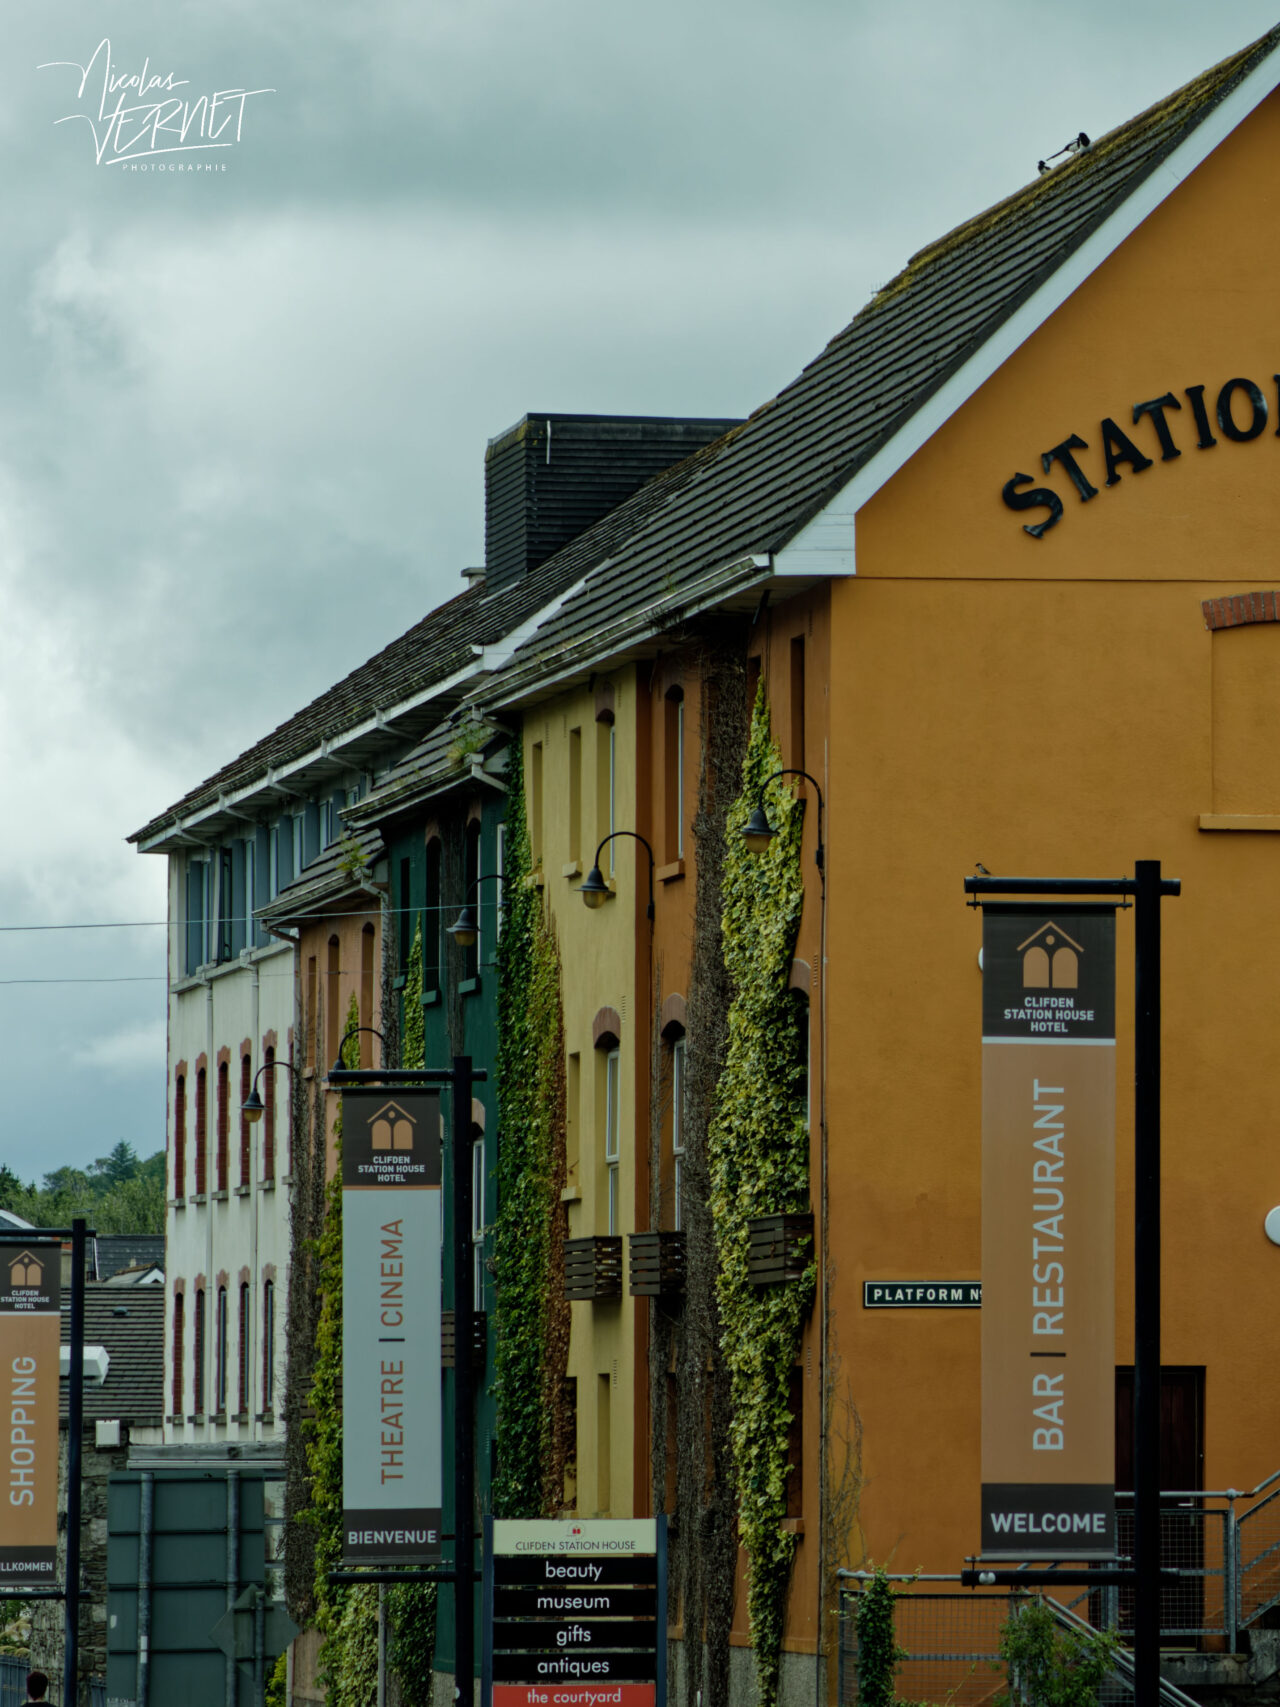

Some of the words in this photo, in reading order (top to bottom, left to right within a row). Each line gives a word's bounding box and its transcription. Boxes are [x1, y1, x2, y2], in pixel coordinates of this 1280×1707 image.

[1024, 996, 1075, 1008] CLIFDEN
[1003, 1008, 1053, 1020] STATION
[1055, 1010, 1095, 1021] HOUSE
[1030, 1021, 1069, 1033] HOTEL
[373, 1155, 411, 1164] CLIFDEN
[357, 1164, 394, 1173] STATION
[396, 1164, 425, 1173] HOUSE
[377, 1173, 406, 1182] HOTEL
[1033, 1078, 1065, 1336] RESTAURANT
[380, 1219, 404, 1327] CINEMA
[11, 1289, 40, 1297] CLIFDEN
[873, 1288, 963, 1301] PLATFORM
[14, 1302, 36, 1310] HOTEL
[1033, 1373, 1065, 1451] BAR
[380, 1360, 404, 1485] THEATRE
[10, 1356, 37, 1507] SHOPPING
[990, 1513, 1106, 1534] WELCOME
[348, 1530, 437, 1545] BIENVENUE
[515, 1541, 556, 1551] CLIFDEN
[559, 1541, 600, 1551] STATION
[602, 1540, 636, 1550] HOUSE
[0, 1562, 53, 1572] LLKOMMEN
[545, 1560, 602, 1582] beauty
[537, 1596, 610, 1610] museum
[556, 1625, 592, 1646] gifts
[537, 1657, 610, 1678] antiques
[527, 1688, 548, 1703] the
[553, 1688, 622, 1706] courtyard
